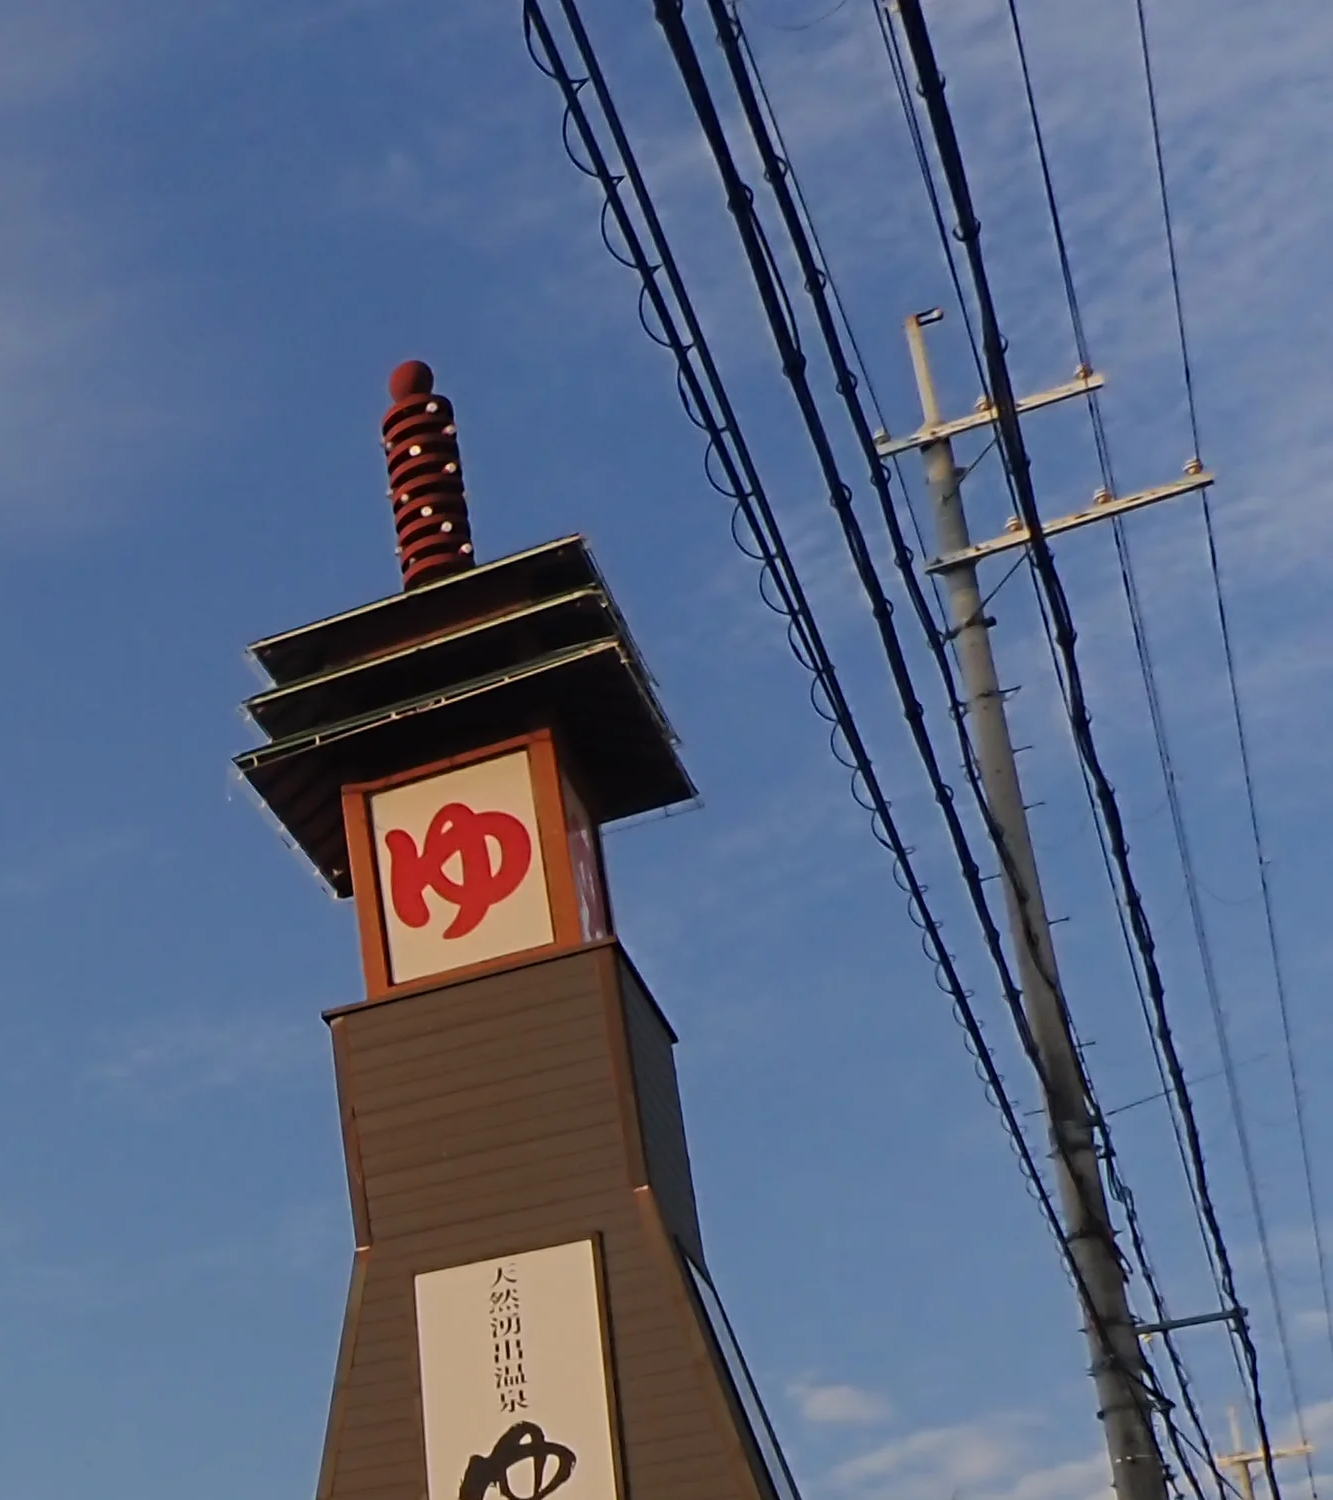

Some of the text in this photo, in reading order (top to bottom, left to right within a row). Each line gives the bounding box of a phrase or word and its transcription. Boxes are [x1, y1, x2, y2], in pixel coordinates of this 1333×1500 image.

[385, 802, 532, 939] ゆ
[488, 1262, 529, 1413] 天然湧出温泉
